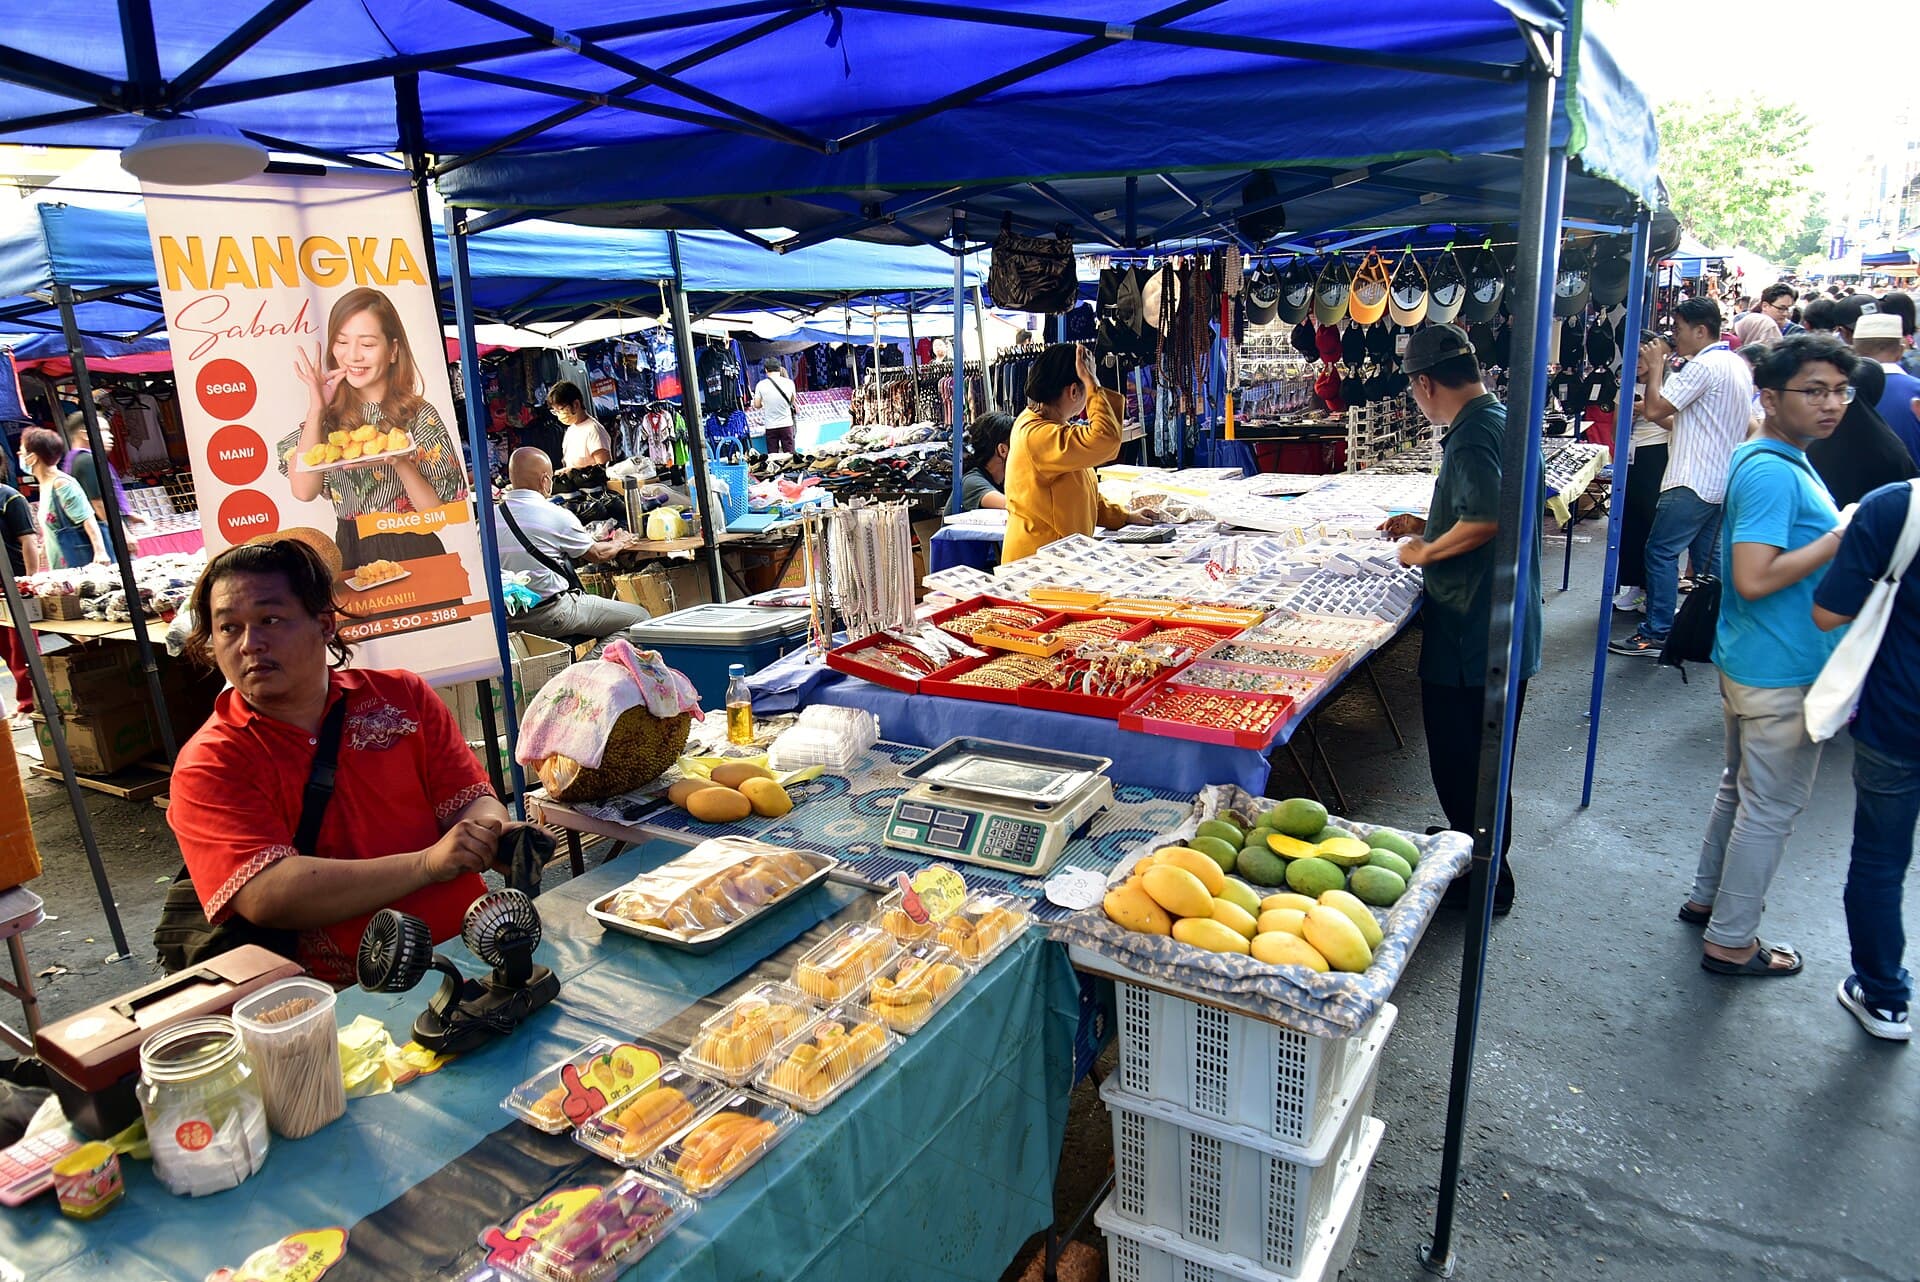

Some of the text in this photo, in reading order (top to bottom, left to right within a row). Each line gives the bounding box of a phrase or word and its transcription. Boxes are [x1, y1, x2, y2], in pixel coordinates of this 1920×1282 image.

[158, 235, 427, 291] NANGKA
[174, 294, 320, 361] Sabah
[227, 512, 269, 528] WANGI
[424, 510, 446, 525] SIM
[392, 614, 422, 629] 300
[431, 608, 458, 622] 3188
